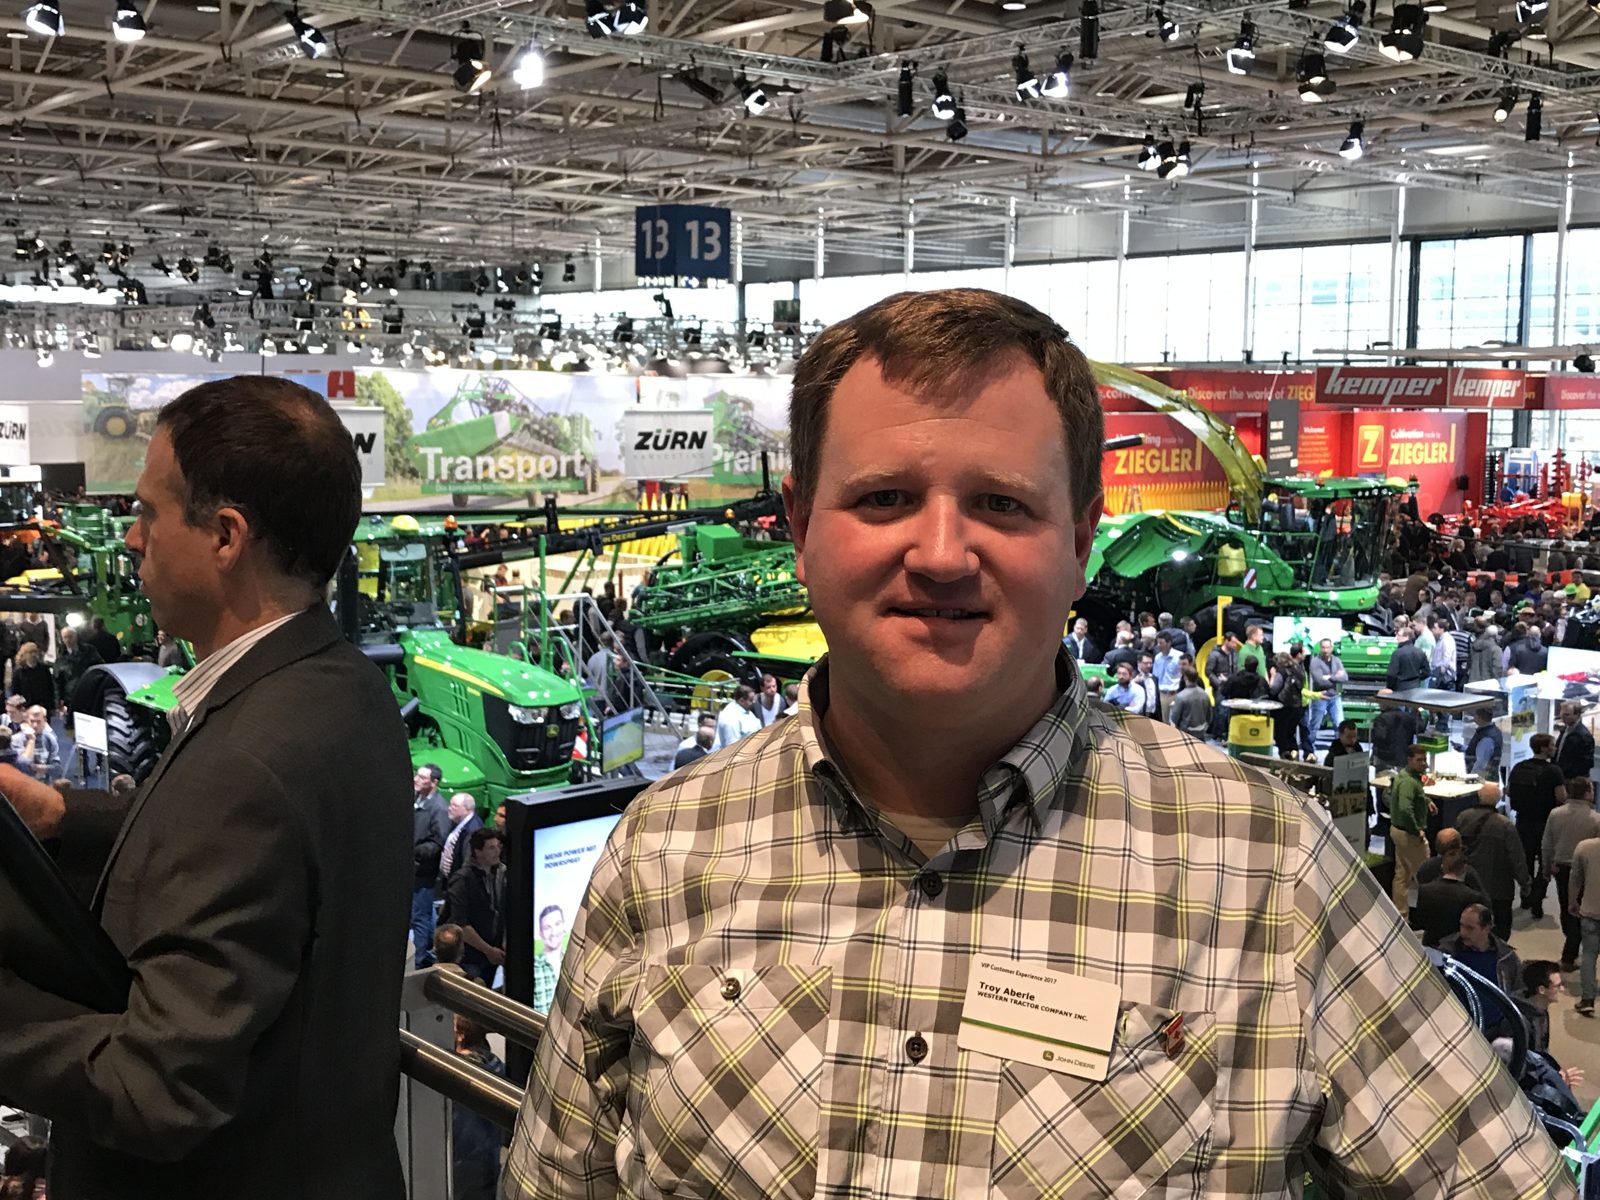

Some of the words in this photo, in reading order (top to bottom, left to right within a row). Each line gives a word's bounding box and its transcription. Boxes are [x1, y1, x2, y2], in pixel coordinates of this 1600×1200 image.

[641, 219, 669, 259] 13
[685, 220, 721, 261] 13
[1188, 387, 1227, 400] Discover
[1229, 387, 1246, 400] the
[1246, 387, 1273, 400] world
[1274, 387, 1285, 400] of
[1324, 367, 1443, 406] kemper
[1453, 368, 1522, 407] kemper
[634, 428, 708, 451] ZÜRN
[418, 446, 587, 482] Transport
[1114, 448, 1192, 475] ZIEGLER
[1389, 442, 1448, 465] ZIEGLER
[990, 964, 1015, 974] Customer
[1015, 970, 1043, 982] Experience
[1043, 976, 1057, 984] 2017
[979, 981, 1001, 994] Troy
[1003, 987, 1036, 1001] Aberle
[977, 990, 1008, 1002] WESTERN
[1010, 998, 1040, 1010] TRACTOR
[1040, 1005, 1073, 1018] COMPANY
[1074, 1013, 1089, 1022] INC.
[1055, 1055, 1074, 1065] JOHN
[1074, 1059, 1096, 1070] DEERE
